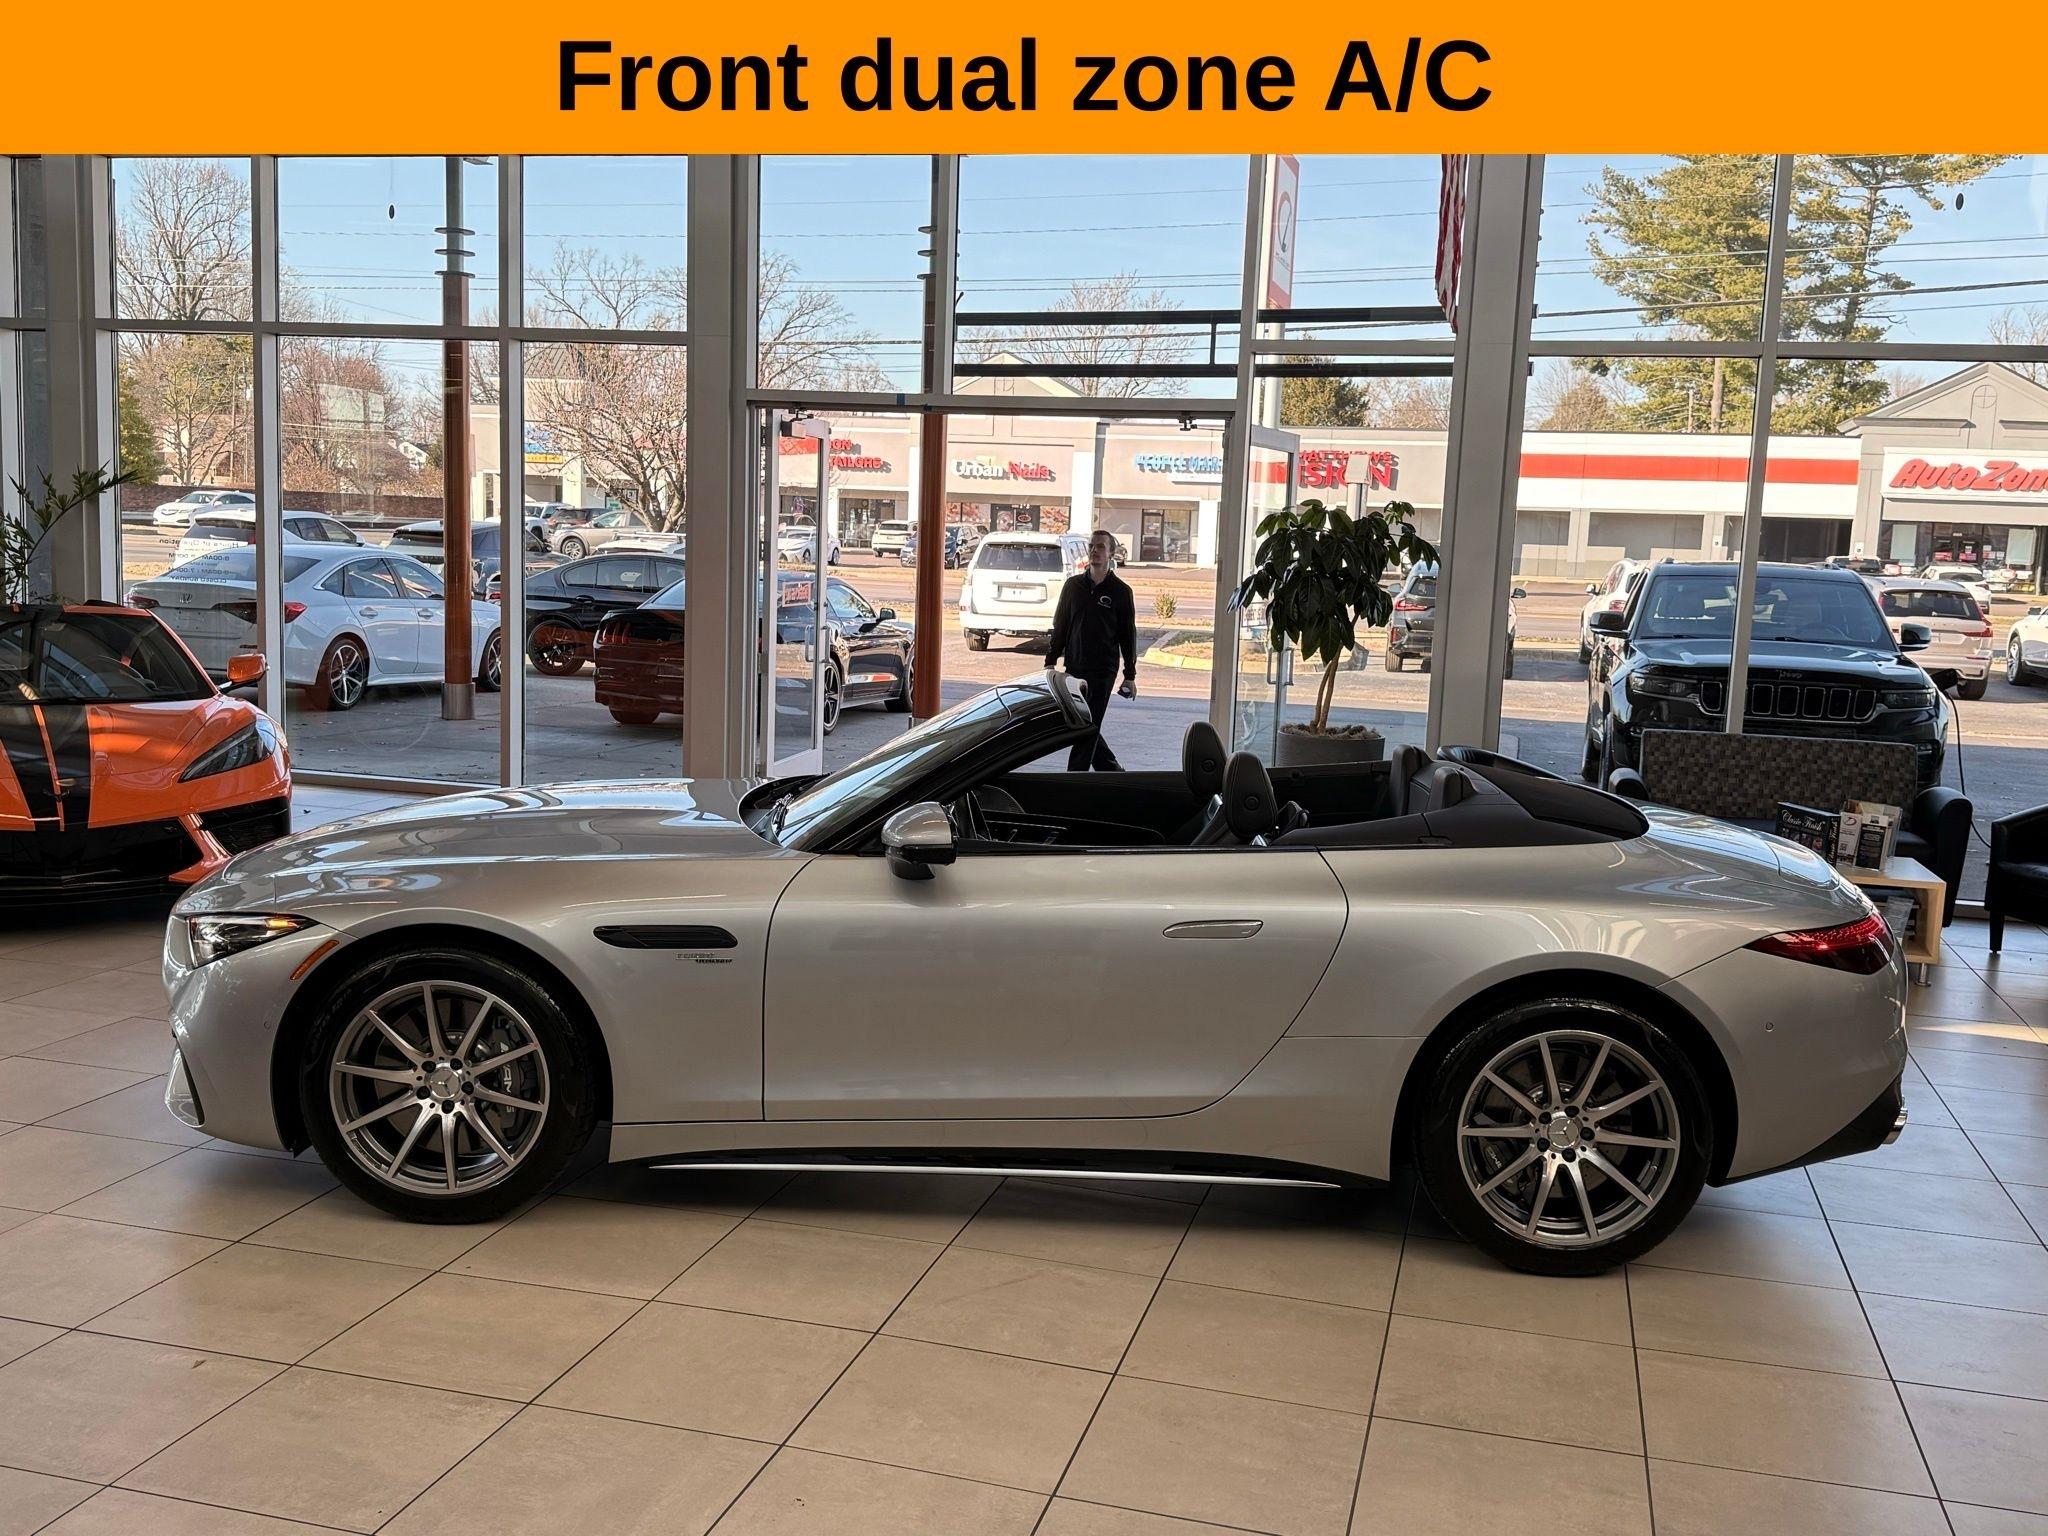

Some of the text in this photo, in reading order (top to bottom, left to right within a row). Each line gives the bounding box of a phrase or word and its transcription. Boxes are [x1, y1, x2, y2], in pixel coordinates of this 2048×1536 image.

[952, 459, 1050, 479] Urban Nails
[1889, 458, 2048, 492] AutoZon
